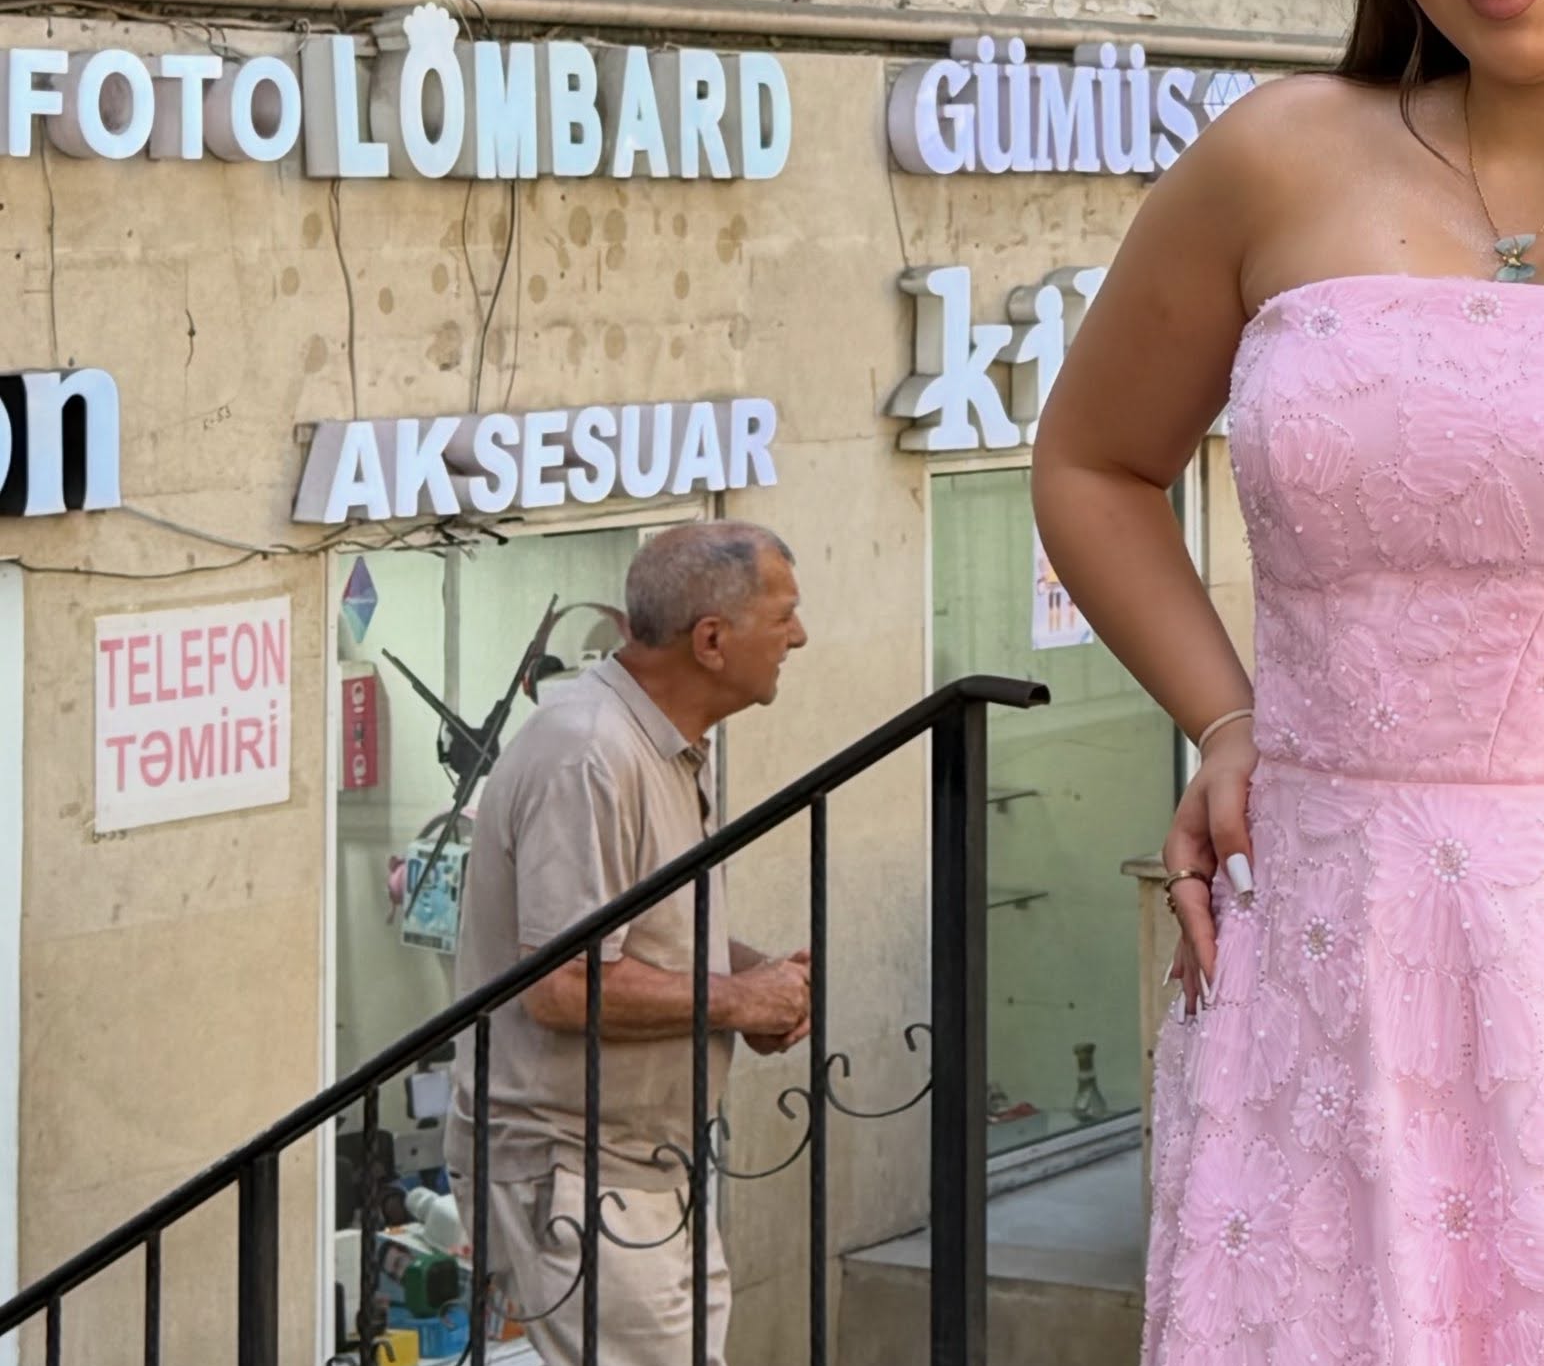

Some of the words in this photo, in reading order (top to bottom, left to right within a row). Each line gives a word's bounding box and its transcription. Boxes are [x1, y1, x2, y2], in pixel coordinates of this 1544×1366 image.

[9, 48, 301, 161] FOTO
[330, 2, 792, 180] LOMBARD
[914, 266, 1107, 449] ki
[0, 367, 122, 517] n
[322, 398, 778, 523] AKSESUAR
[100, 618, 286, 708] TELEFON
[105, 699, 279, 792] TƏMİRİ
